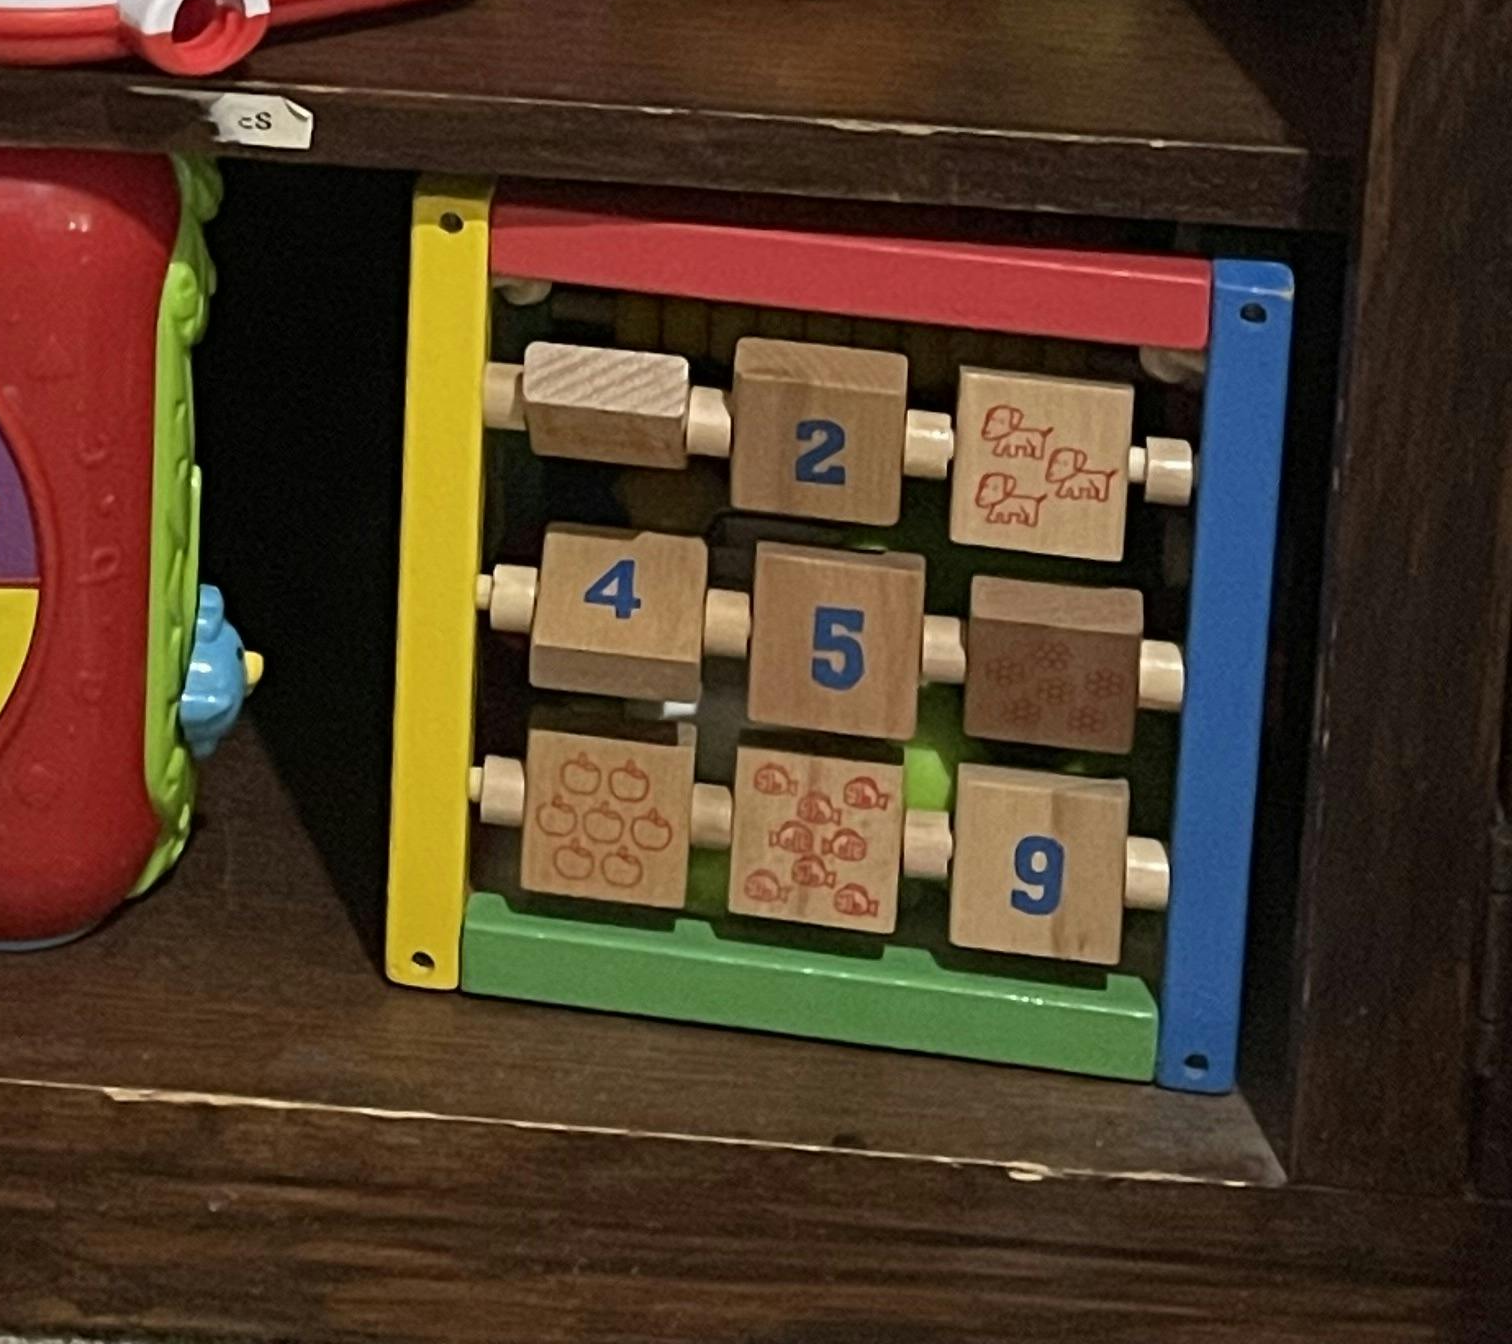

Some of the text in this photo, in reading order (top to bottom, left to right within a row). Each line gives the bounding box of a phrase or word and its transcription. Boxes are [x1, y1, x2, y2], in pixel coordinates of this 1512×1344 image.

[795, 419, 846, 486] 2
[583, 558, 642, 620] 4
[811, 605, 866, 691] 5
[1010, 835, 1066, 916] 9
